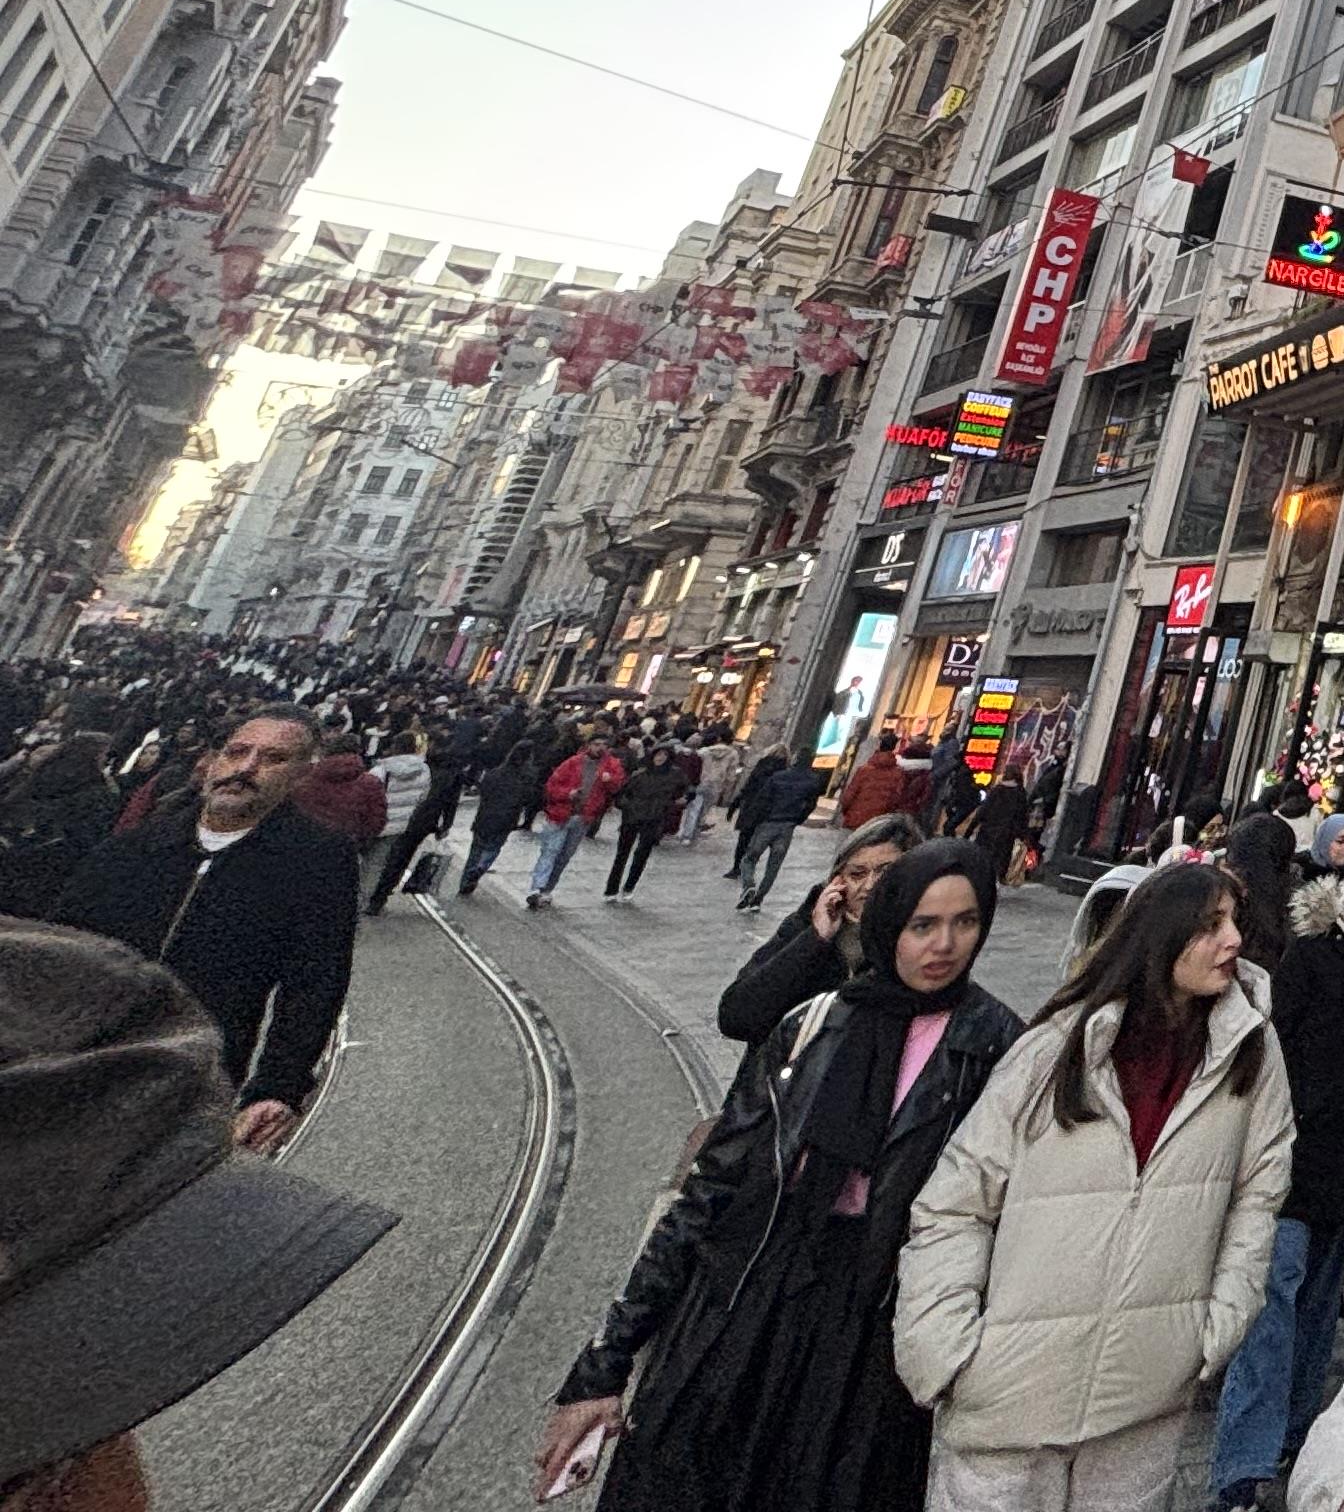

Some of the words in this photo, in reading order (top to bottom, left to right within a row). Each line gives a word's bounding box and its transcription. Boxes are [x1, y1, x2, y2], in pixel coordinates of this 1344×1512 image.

[1024, 236, 1077, 333] CHP
[1210, 359, 1258, 410] PARROT
[1261, 343, 1298, 389] CAFE
